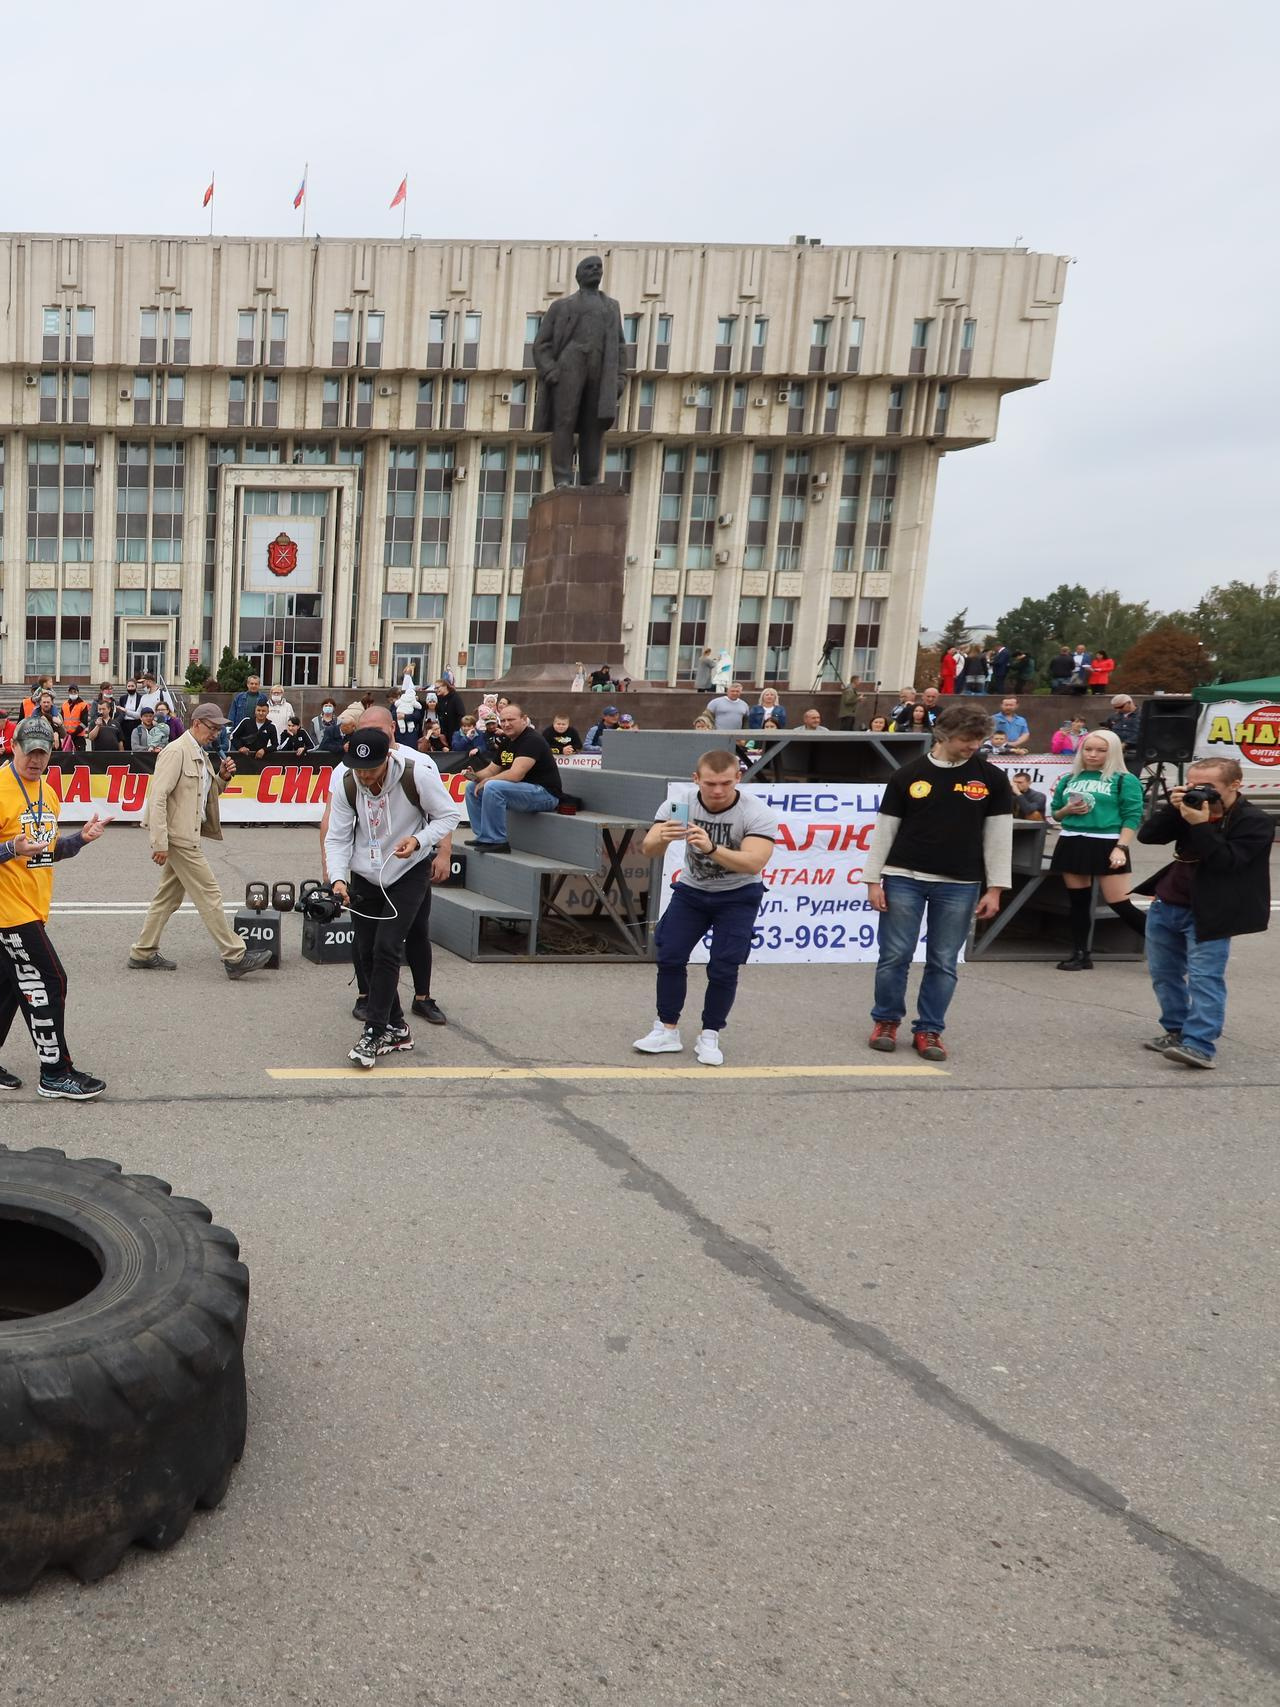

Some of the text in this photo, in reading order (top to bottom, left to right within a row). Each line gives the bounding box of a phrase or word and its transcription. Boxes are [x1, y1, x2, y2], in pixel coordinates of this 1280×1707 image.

[238, 927, 275, 941] 240
[324, 931, 355, 945] 200
[30, 1012, 61, 1065] GET
